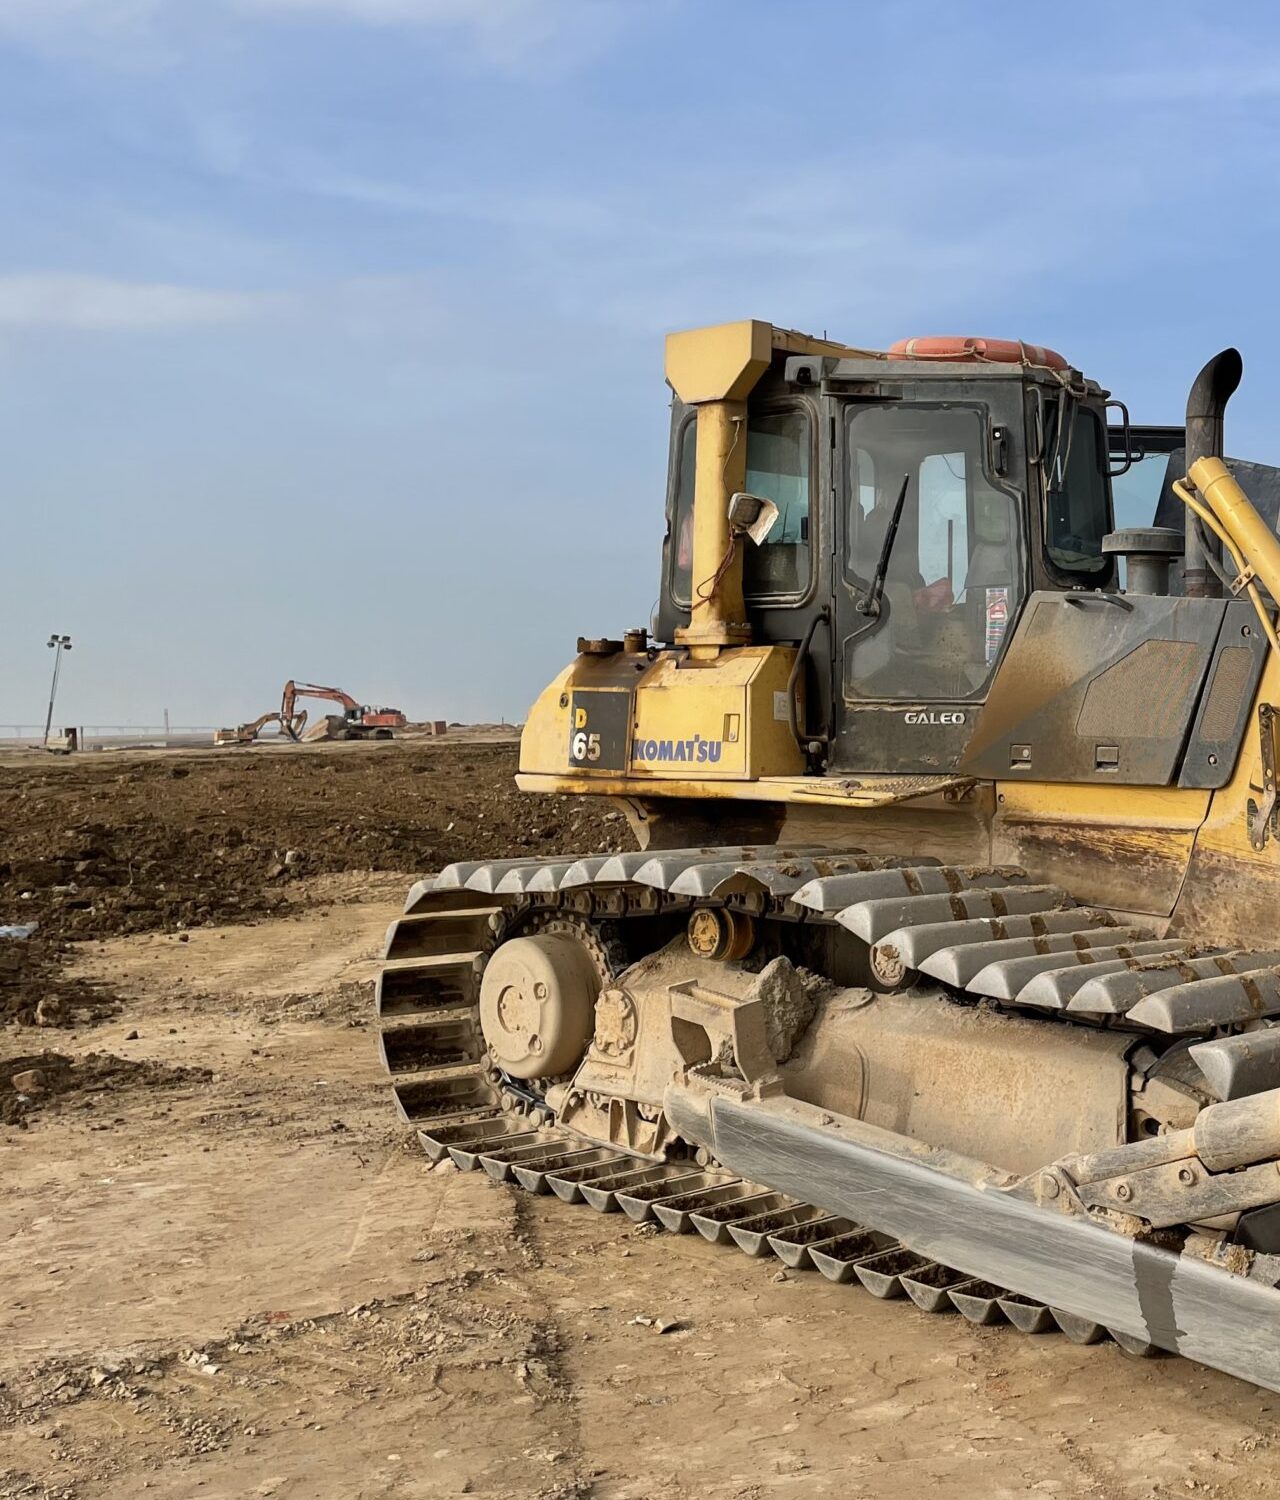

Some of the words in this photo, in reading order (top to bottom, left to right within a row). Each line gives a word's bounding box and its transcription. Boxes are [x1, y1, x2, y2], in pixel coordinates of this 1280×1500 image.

[575, 708, 587, 729] D
[904, 712, 966, 725] GALEO
[572, 732, 601, 761] 65
[633, 734, 721, 762] KOMATSU
